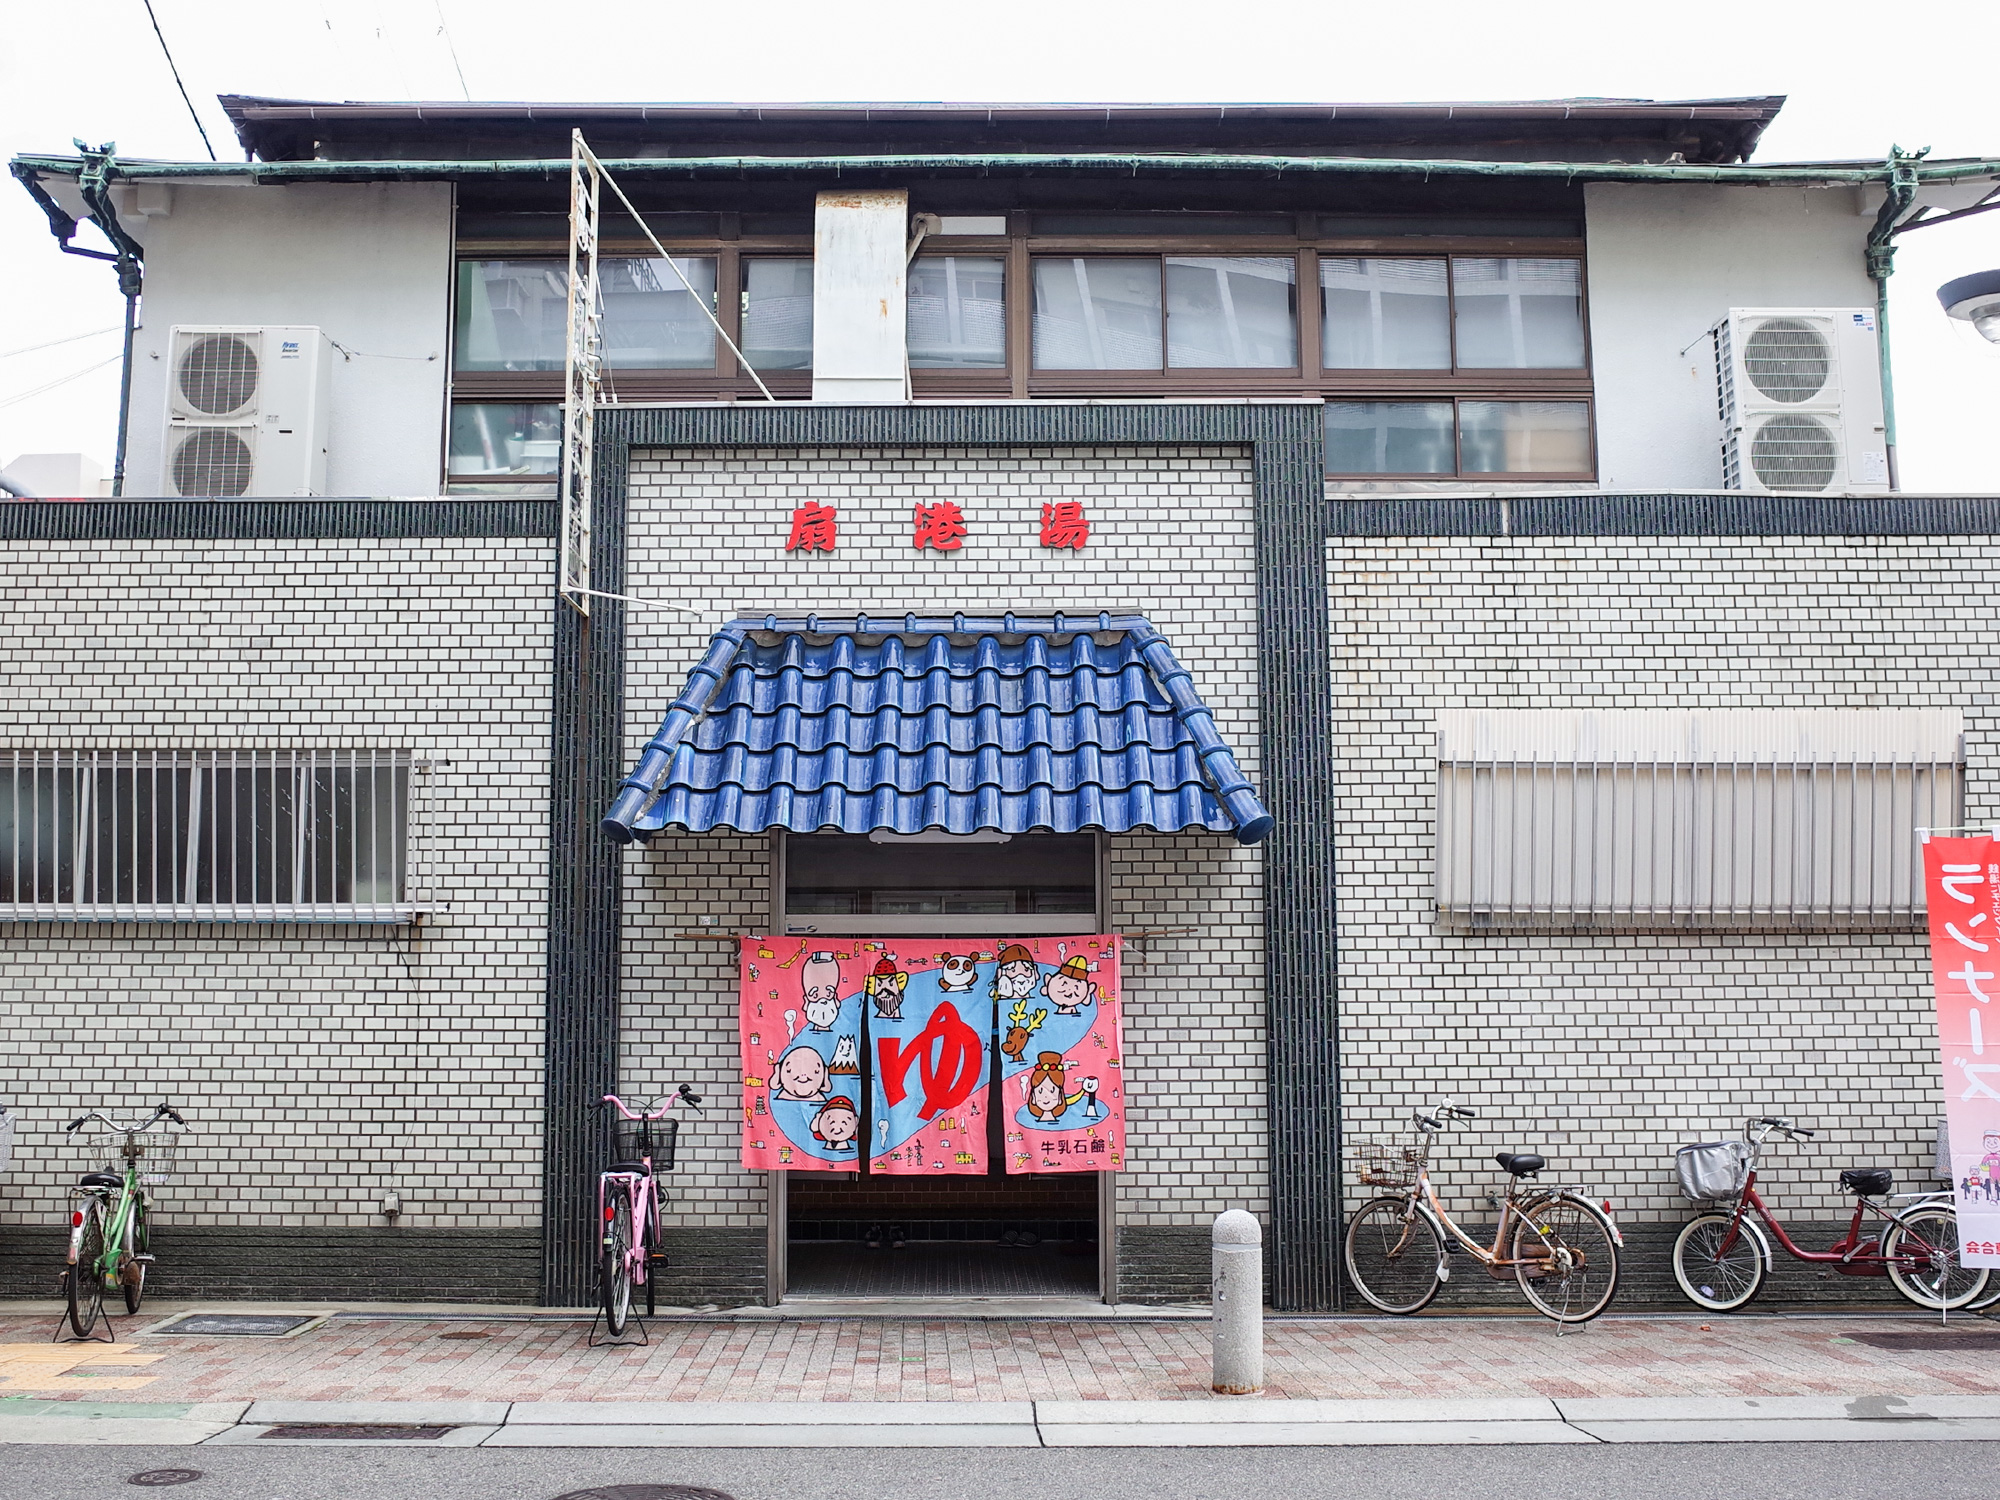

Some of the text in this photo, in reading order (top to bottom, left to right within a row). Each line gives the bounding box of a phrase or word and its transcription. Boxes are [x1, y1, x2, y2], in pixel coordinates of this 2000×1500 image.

[785, 501, 1090, 552] 扇港湯
[877, 1000, 982, 1121] ゆ
